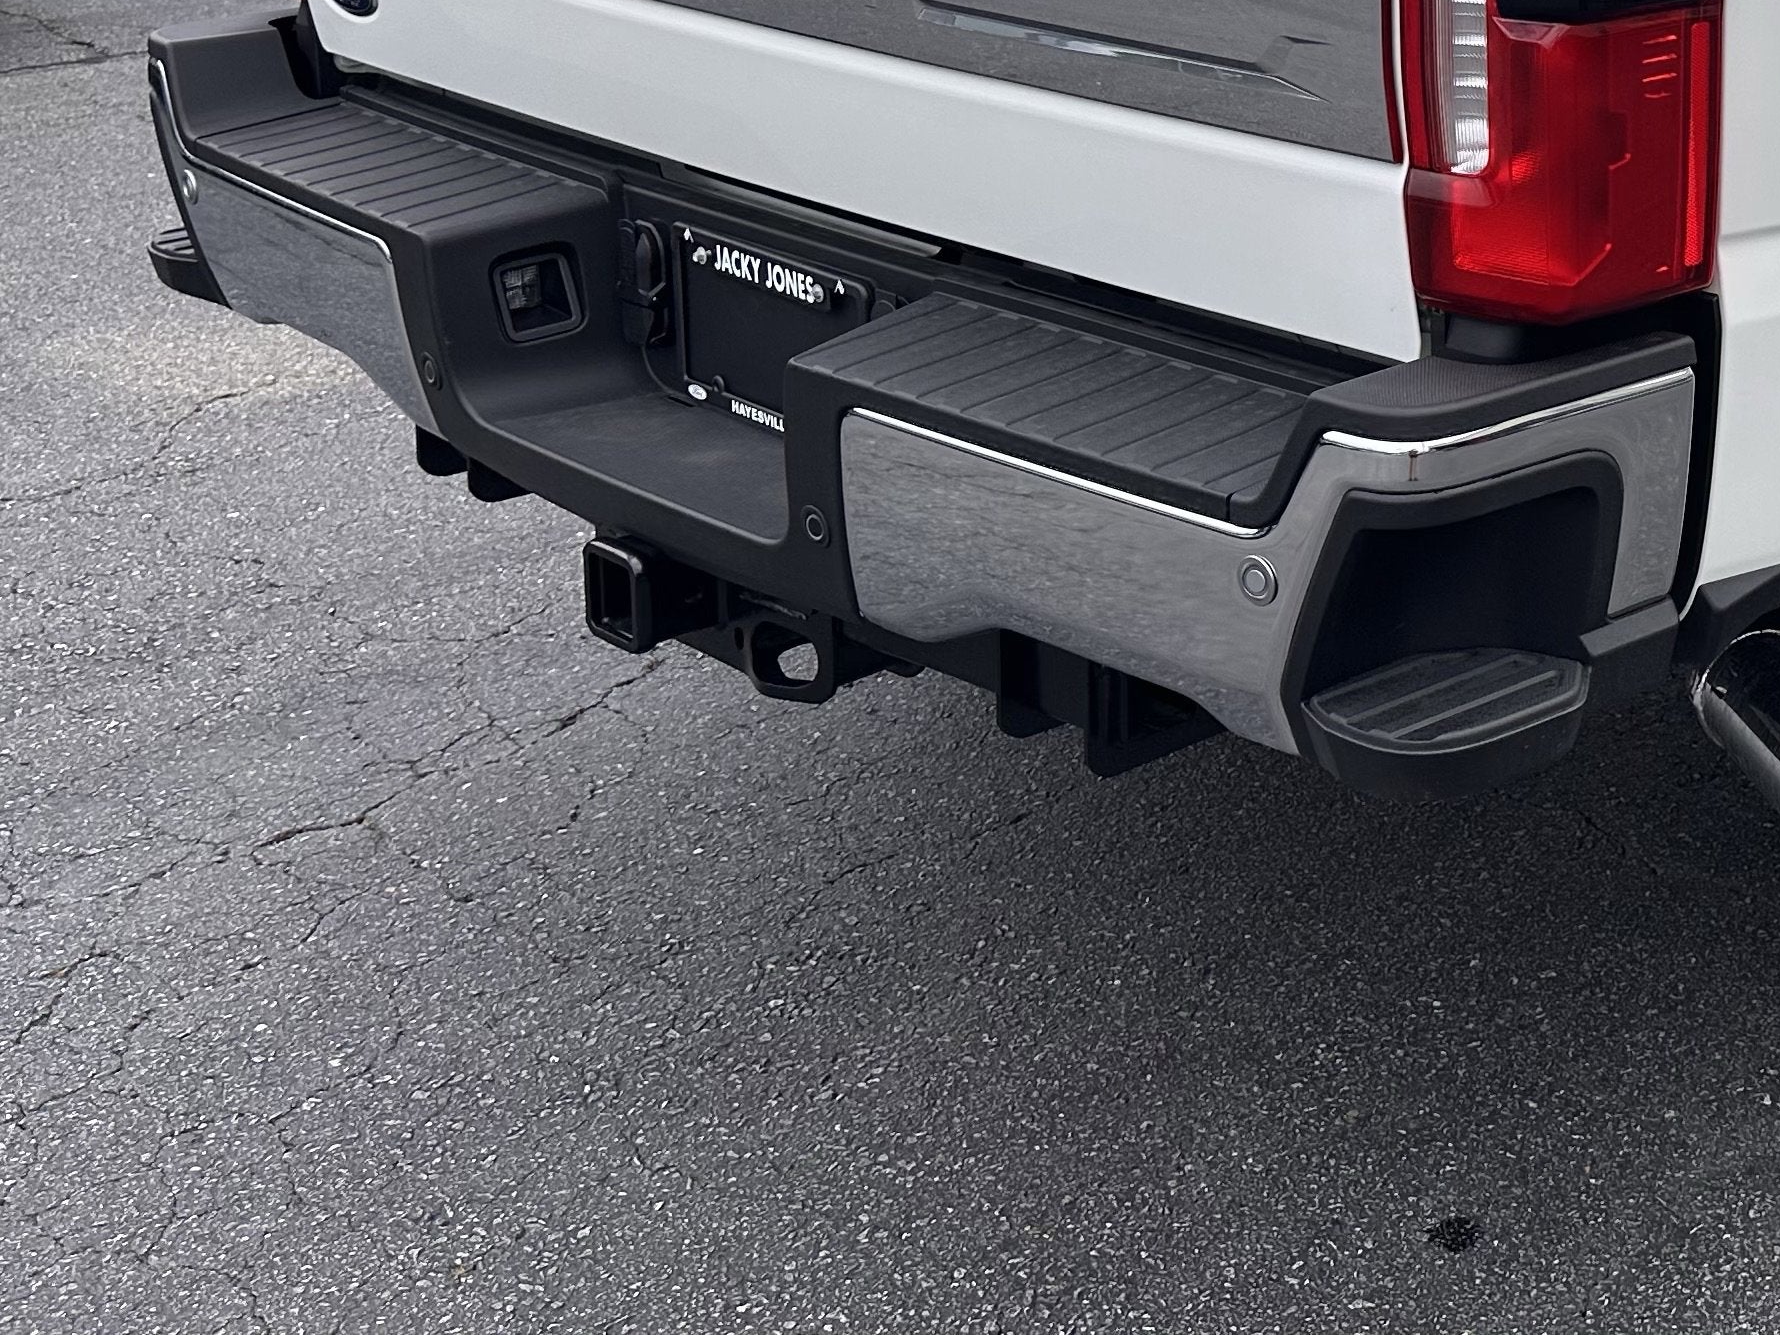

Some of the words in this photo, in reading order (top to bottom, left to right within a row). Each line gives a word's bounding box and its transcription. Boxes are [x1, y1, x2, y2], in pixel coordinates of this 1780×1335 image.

[714, 244, 762, 284] JACKY
[765, 262, 817, 304] JONES
[731, 399, 785, 433] HAYESVILL
